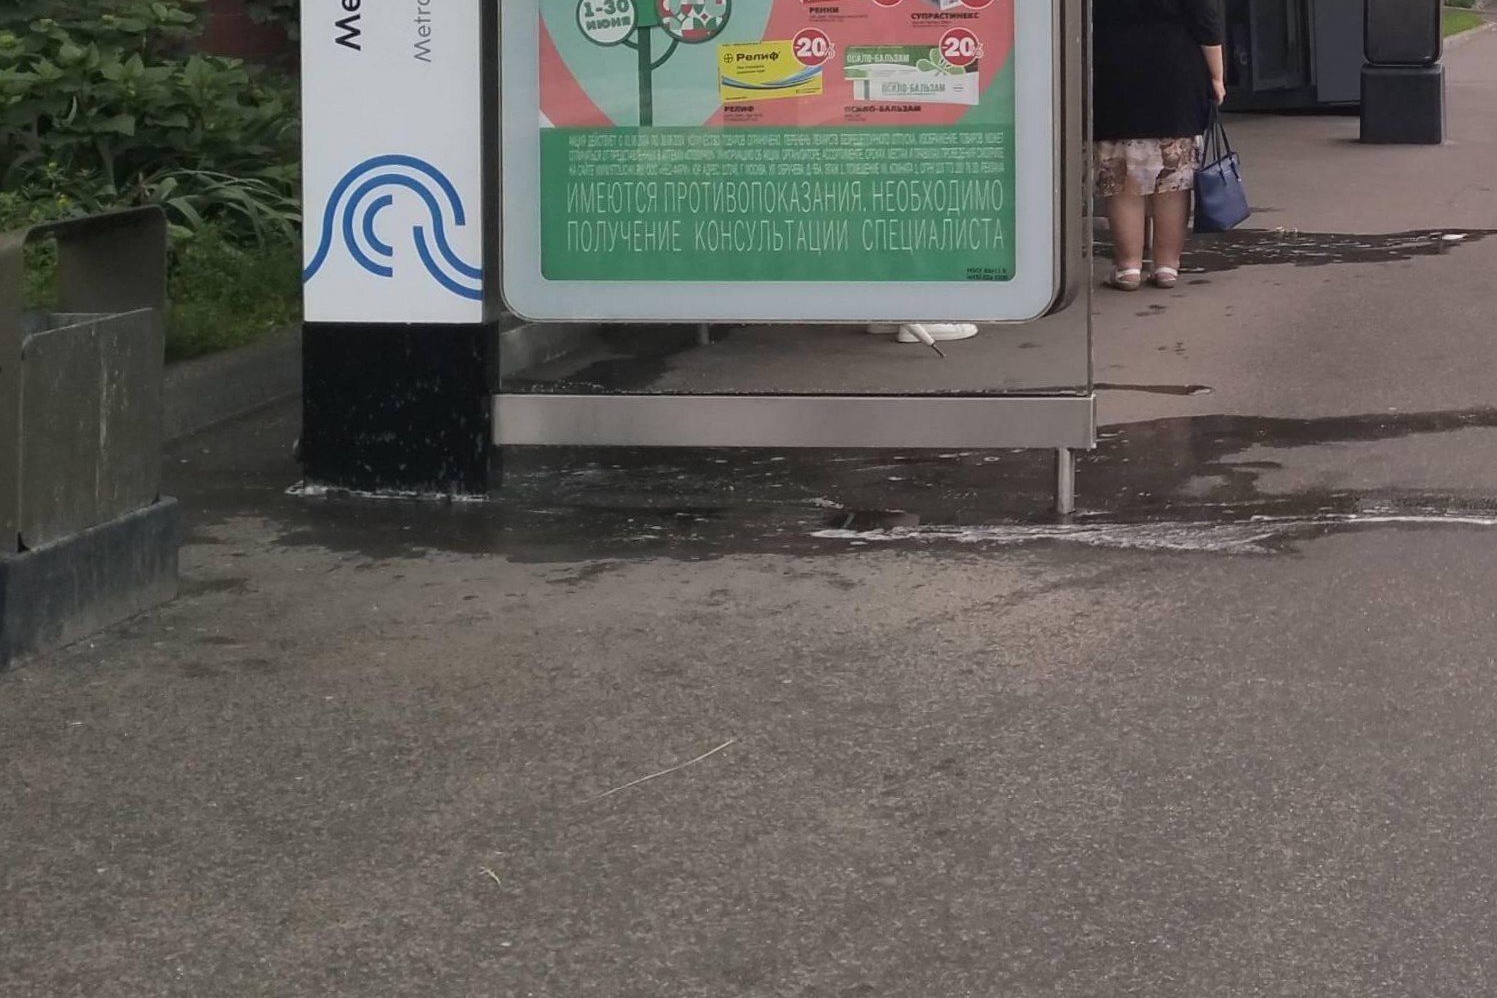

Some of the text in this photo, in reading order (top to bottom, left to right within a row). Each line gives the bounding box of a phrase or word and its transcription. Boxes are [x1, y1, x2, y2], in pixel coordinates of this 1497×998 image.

[736, 51, 780, 62] Релиф
[566, 179, 1004, 216] ИМЕЮТСЯ ПРОТИВОПОКАЗАНИЯ. НЕОБХОДИМО
[566, 218, 1005, 257] ПОЛУЧЕНИЕ КОНСУЛЬТАЦИИ СПЕЦИАЛИСТА
